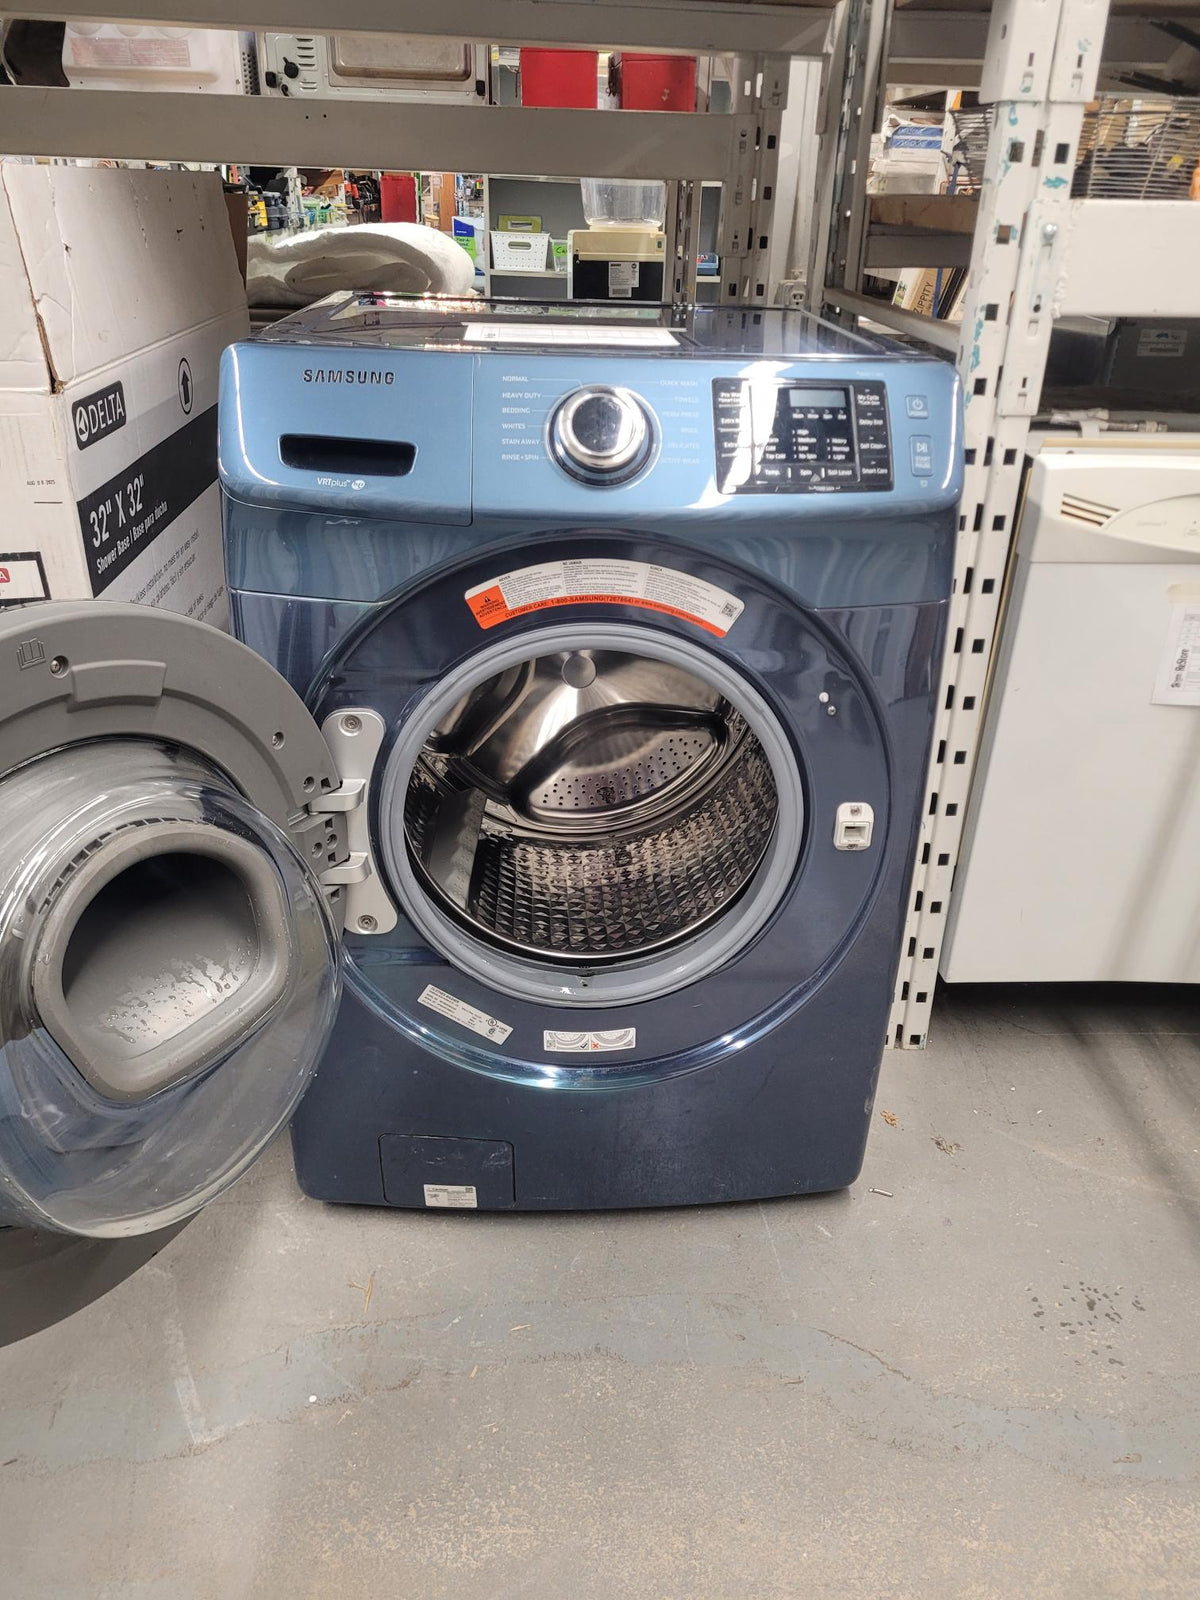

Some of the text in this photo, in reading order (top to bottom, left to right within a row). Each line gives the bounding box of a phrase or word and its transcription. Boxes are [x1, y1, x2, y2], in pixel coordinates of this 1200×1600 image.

[303, 369, 395, 385] SAMSUNG
[87, 391, 125, 434] DELTA
[89, 499, 112, 548] 32"
[127, 473, 144, 517] 32"
[96, 547, 117, 575] Shower
[117, 536, 130, 556] Base
[132, 523, 144, 541] Base
[144, 513, 154, 533] para
[505, 605, 533, 618] CUSTOMER
